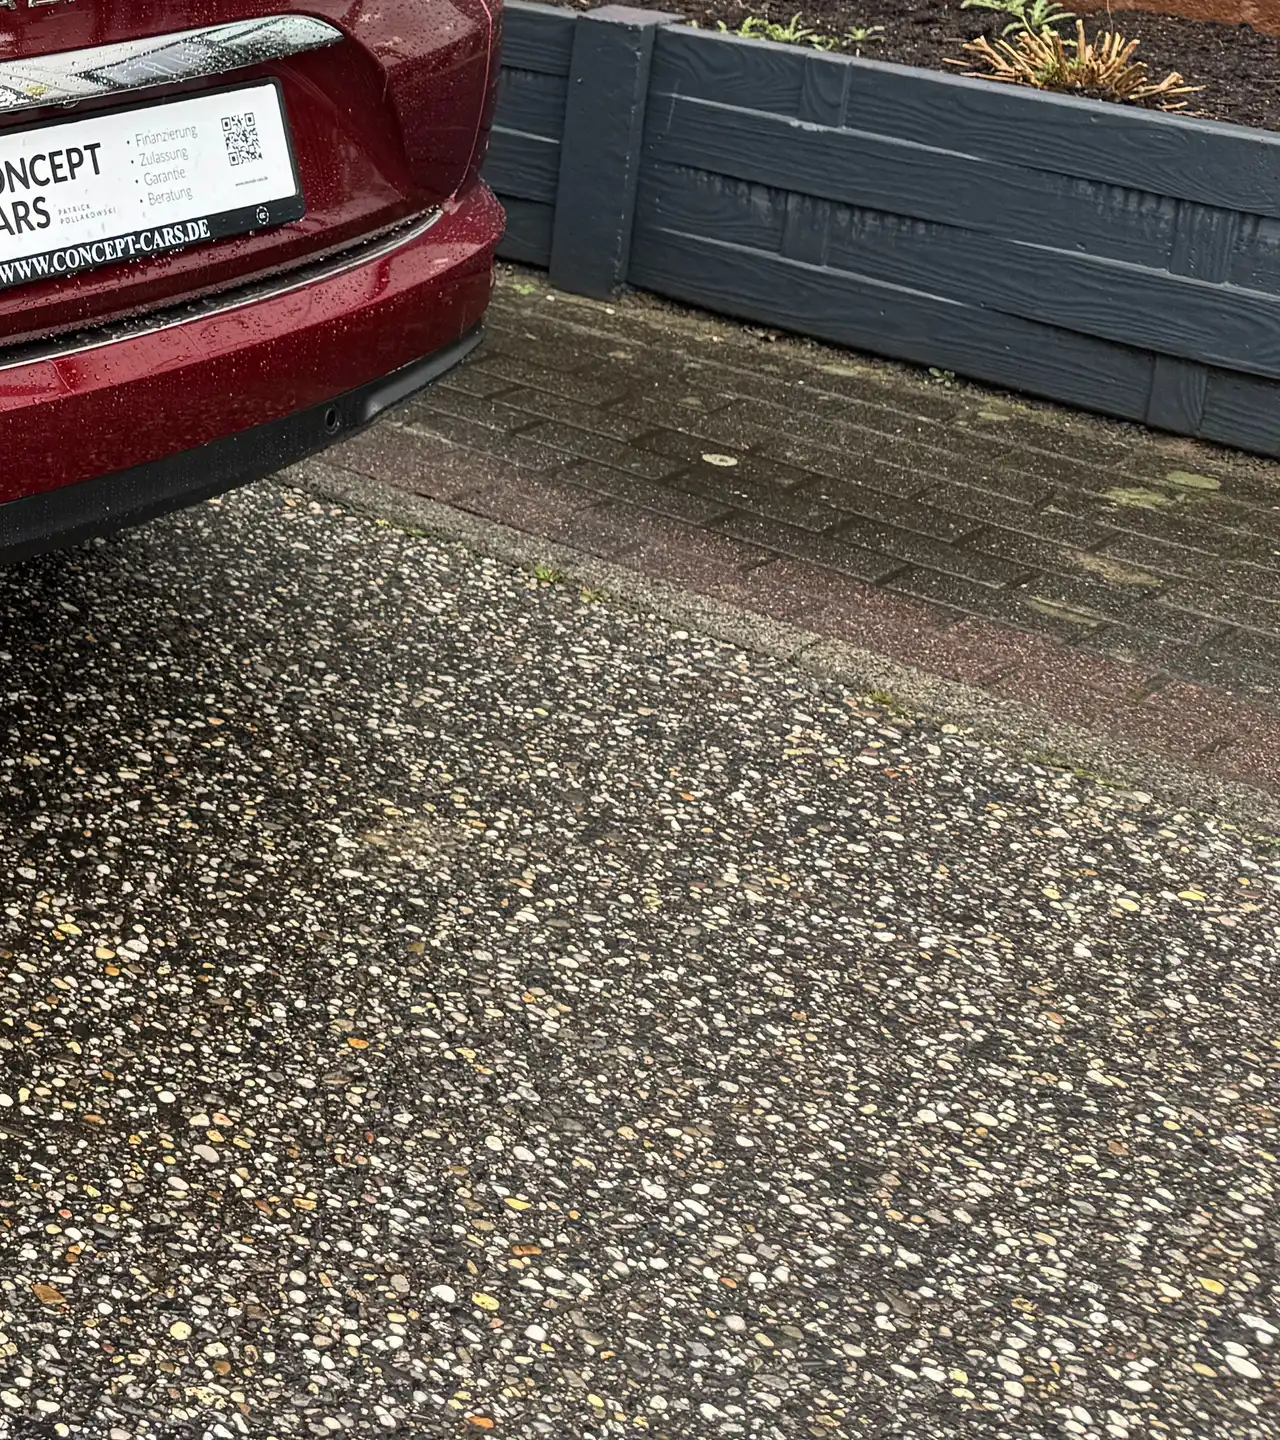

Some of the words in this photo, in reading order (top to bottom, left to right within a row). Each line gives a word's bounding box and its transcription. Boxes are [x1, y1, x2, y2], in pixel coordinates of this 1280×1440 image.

[135, 125, 197, 147] Finanzierung
[140, 148, 188, 166] Zulassung
[144, 166, 186, 186] Garantie
[148, 188, 192, 205] Beratung
[58, 204, 90, 216] PATRICK
[60, 207, 117, 225] POLLAKOWSKI
